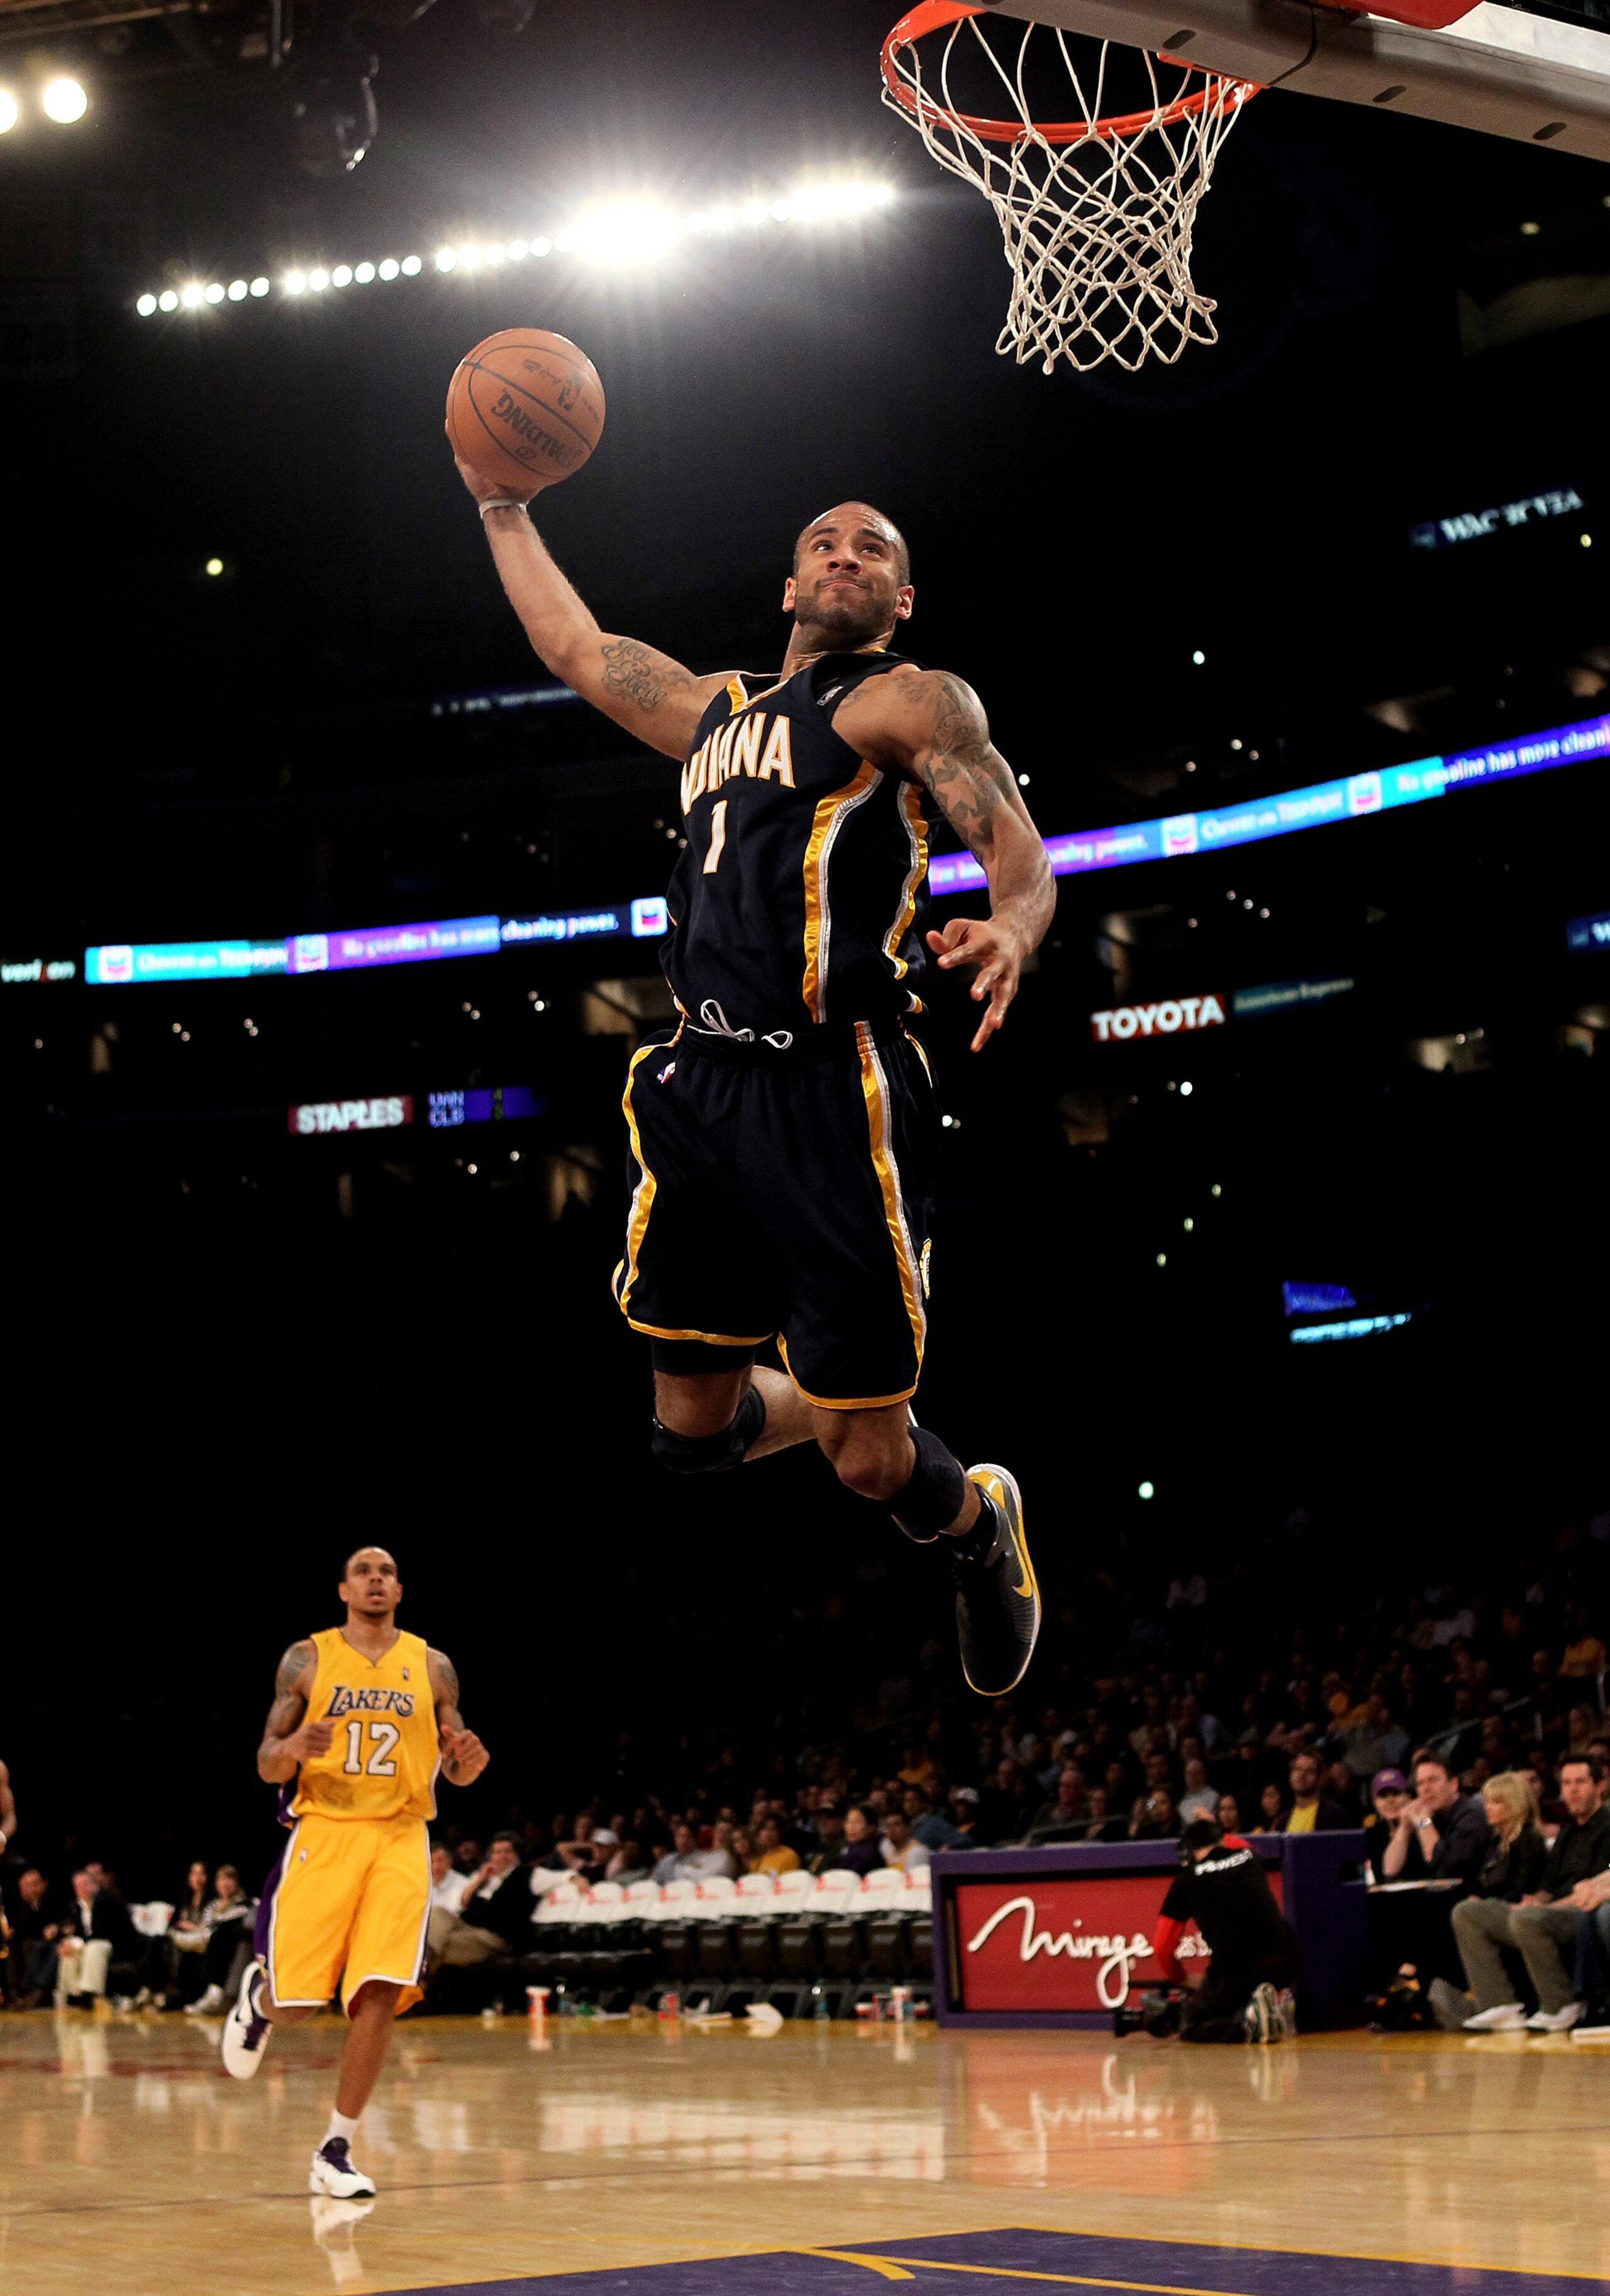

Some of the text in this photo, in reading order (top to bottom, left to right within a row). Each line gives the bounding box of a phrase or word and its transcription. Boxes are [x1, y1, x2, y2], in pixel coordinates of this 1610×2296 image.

[680, 712, 796, 816] NDIANA
[1486, 750, 1517, 774] has
[1517, 739, 1560, 766] more
[703, 800, 728, 874] 1
[1090, 995, 1226, 1042] TOYOTA
[297, 1097, 404, 1134] STAPLES
[325, 1685, 414, 1718] LAKERS
[343, 1720, 400, 1776] 12
